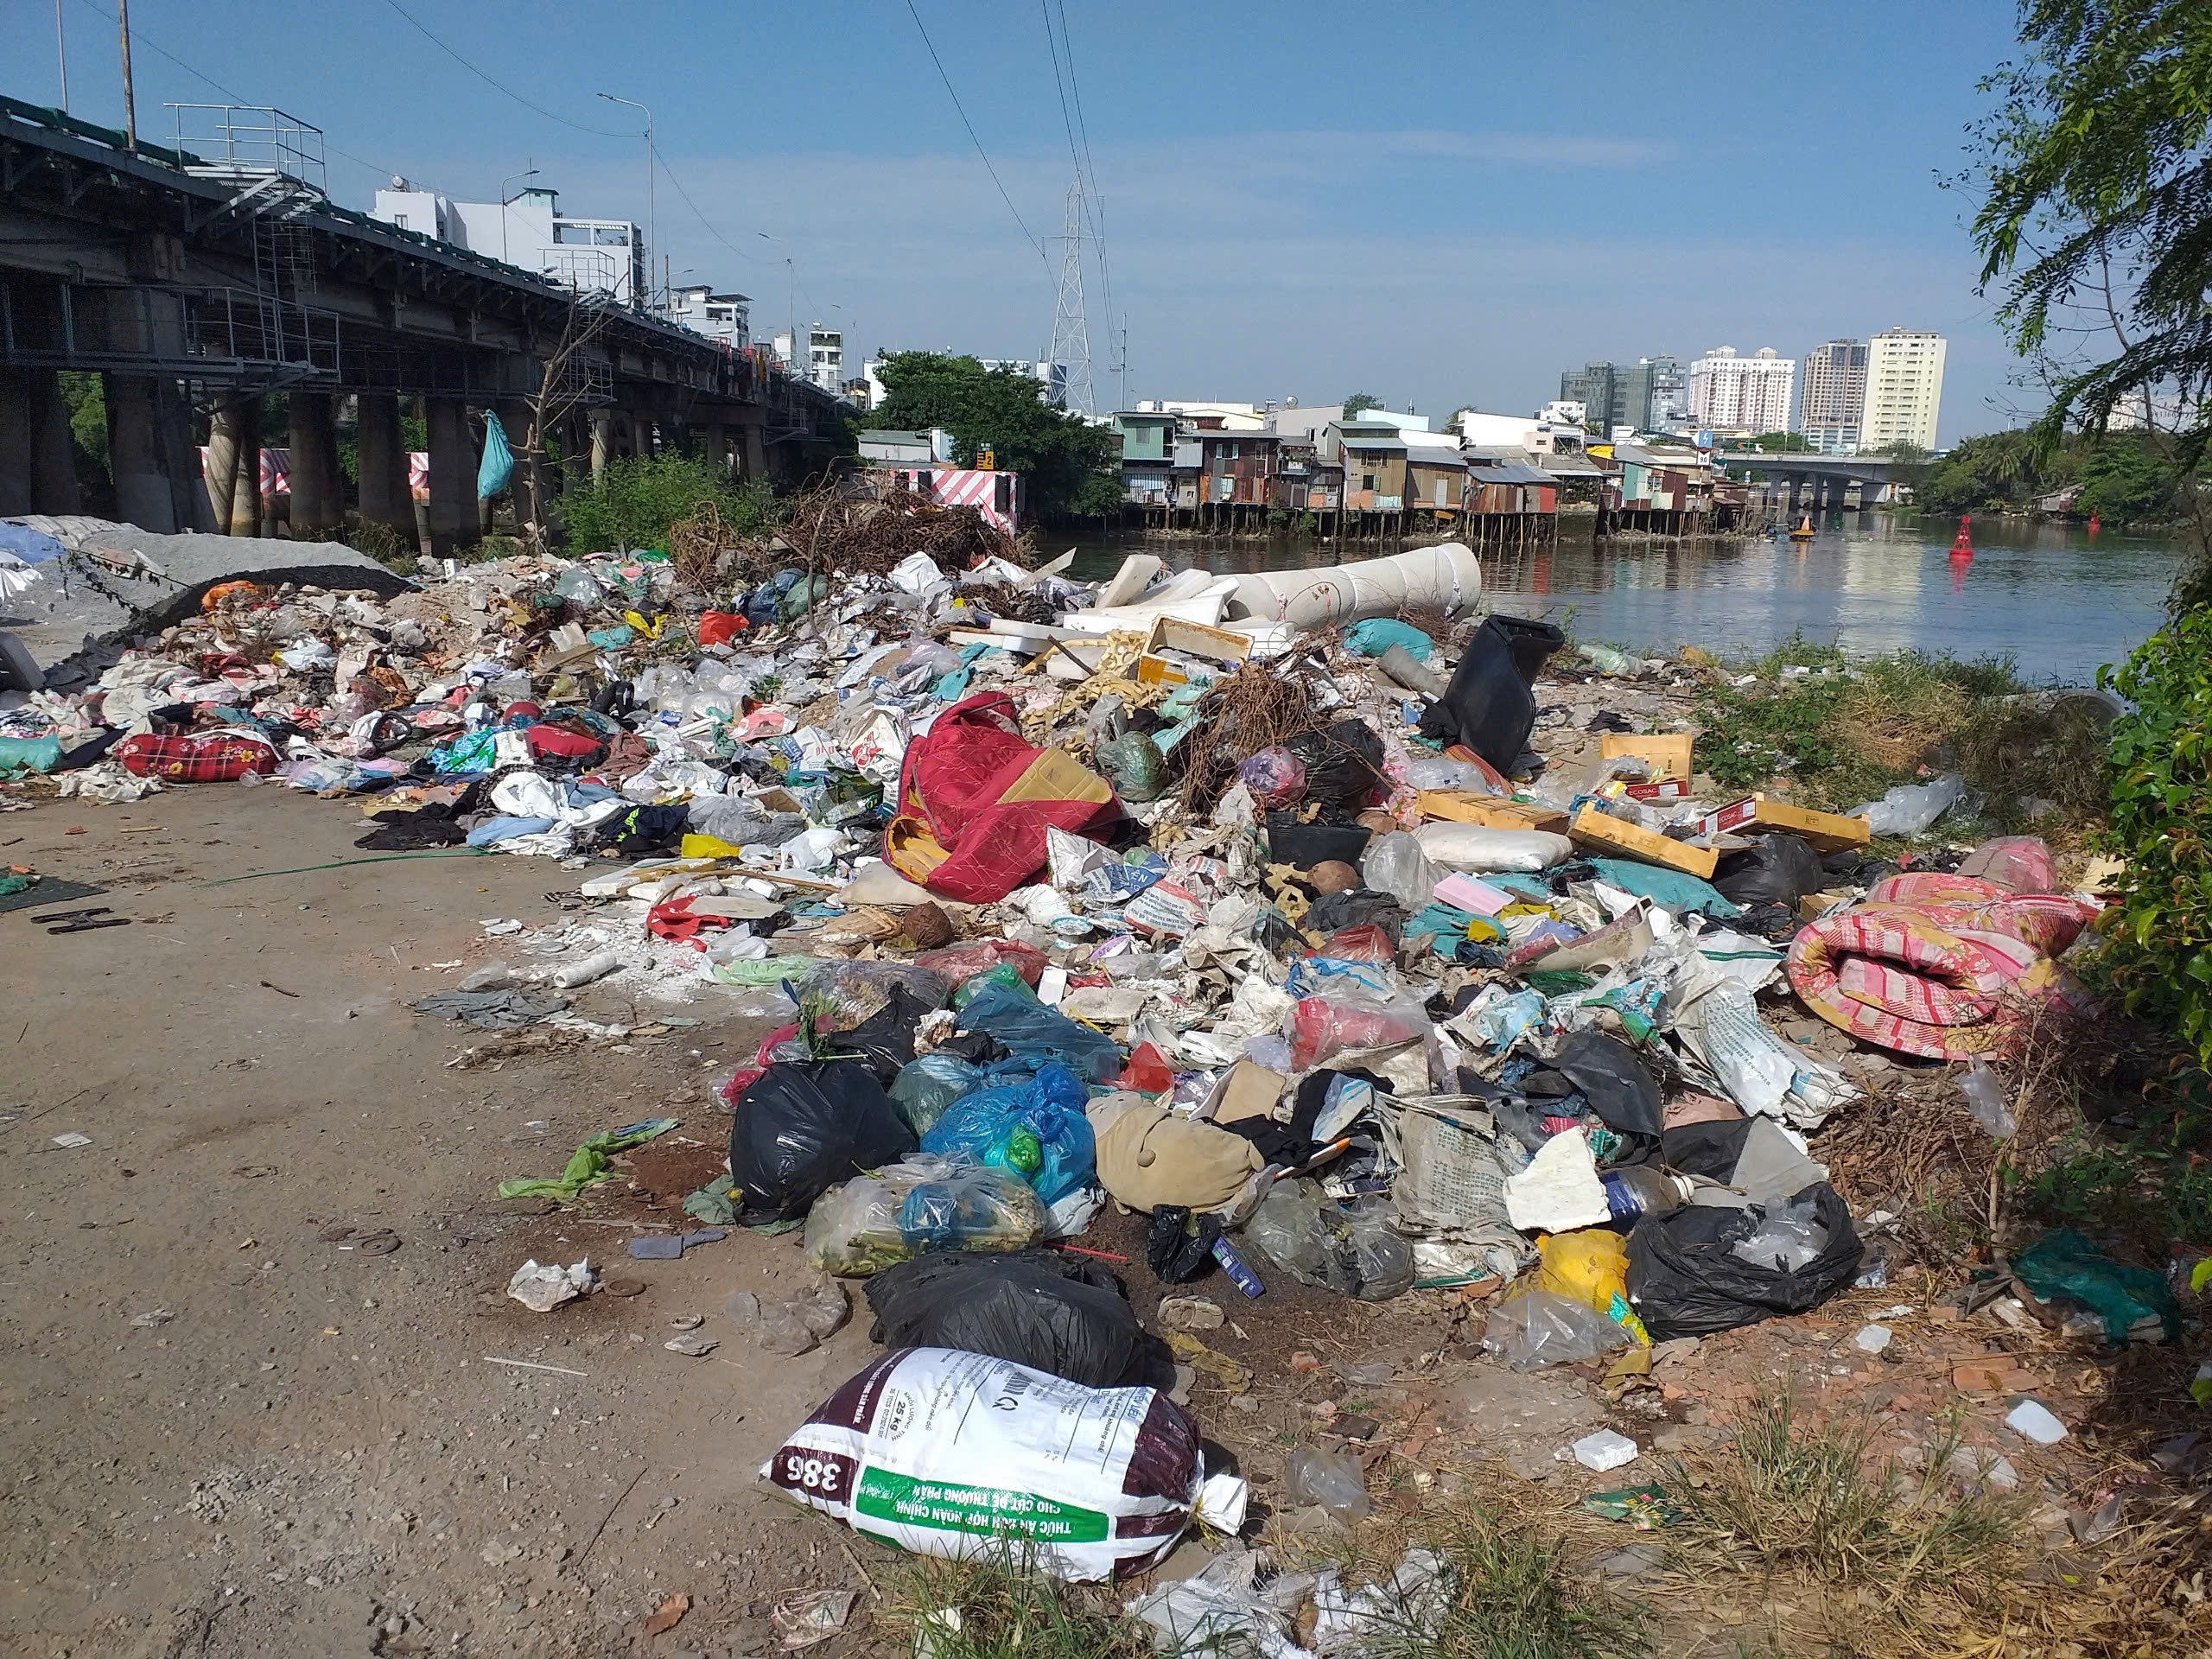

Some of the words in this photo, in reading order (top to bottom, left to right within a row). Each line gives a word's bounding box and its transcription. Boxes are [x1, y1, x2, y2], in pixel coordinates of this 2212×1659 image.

[987, 456, 992, 465] 2
[1629, 787, 1657, 796] ECOSAC
[1718, 810, 1738, 823] ECOSAC
[904, 1391, 914, 1407] KHỐI
[895, 1402, 906, 1415] 25
[889, 1416, 902, 1432] kg
[904, 1407, 915, 1430] LƯỢNG
[891, 1430, 906, 1441] TỊNH
[1102, 1418, 1113, 1440] khoáng
[786, 1455, 842, 1492] 386
[944, 1487, 988, 1509] THƯƠNG
[894, 1501, 930, 1521] CHỈNH
[1036, 1500, 1061, 1515] CHO
[932, 1507, 963, 1526] HOÀN
[965, 1510, 989, 1528] HỢP
[1039, 1521, 1071, 1538] THỨC
